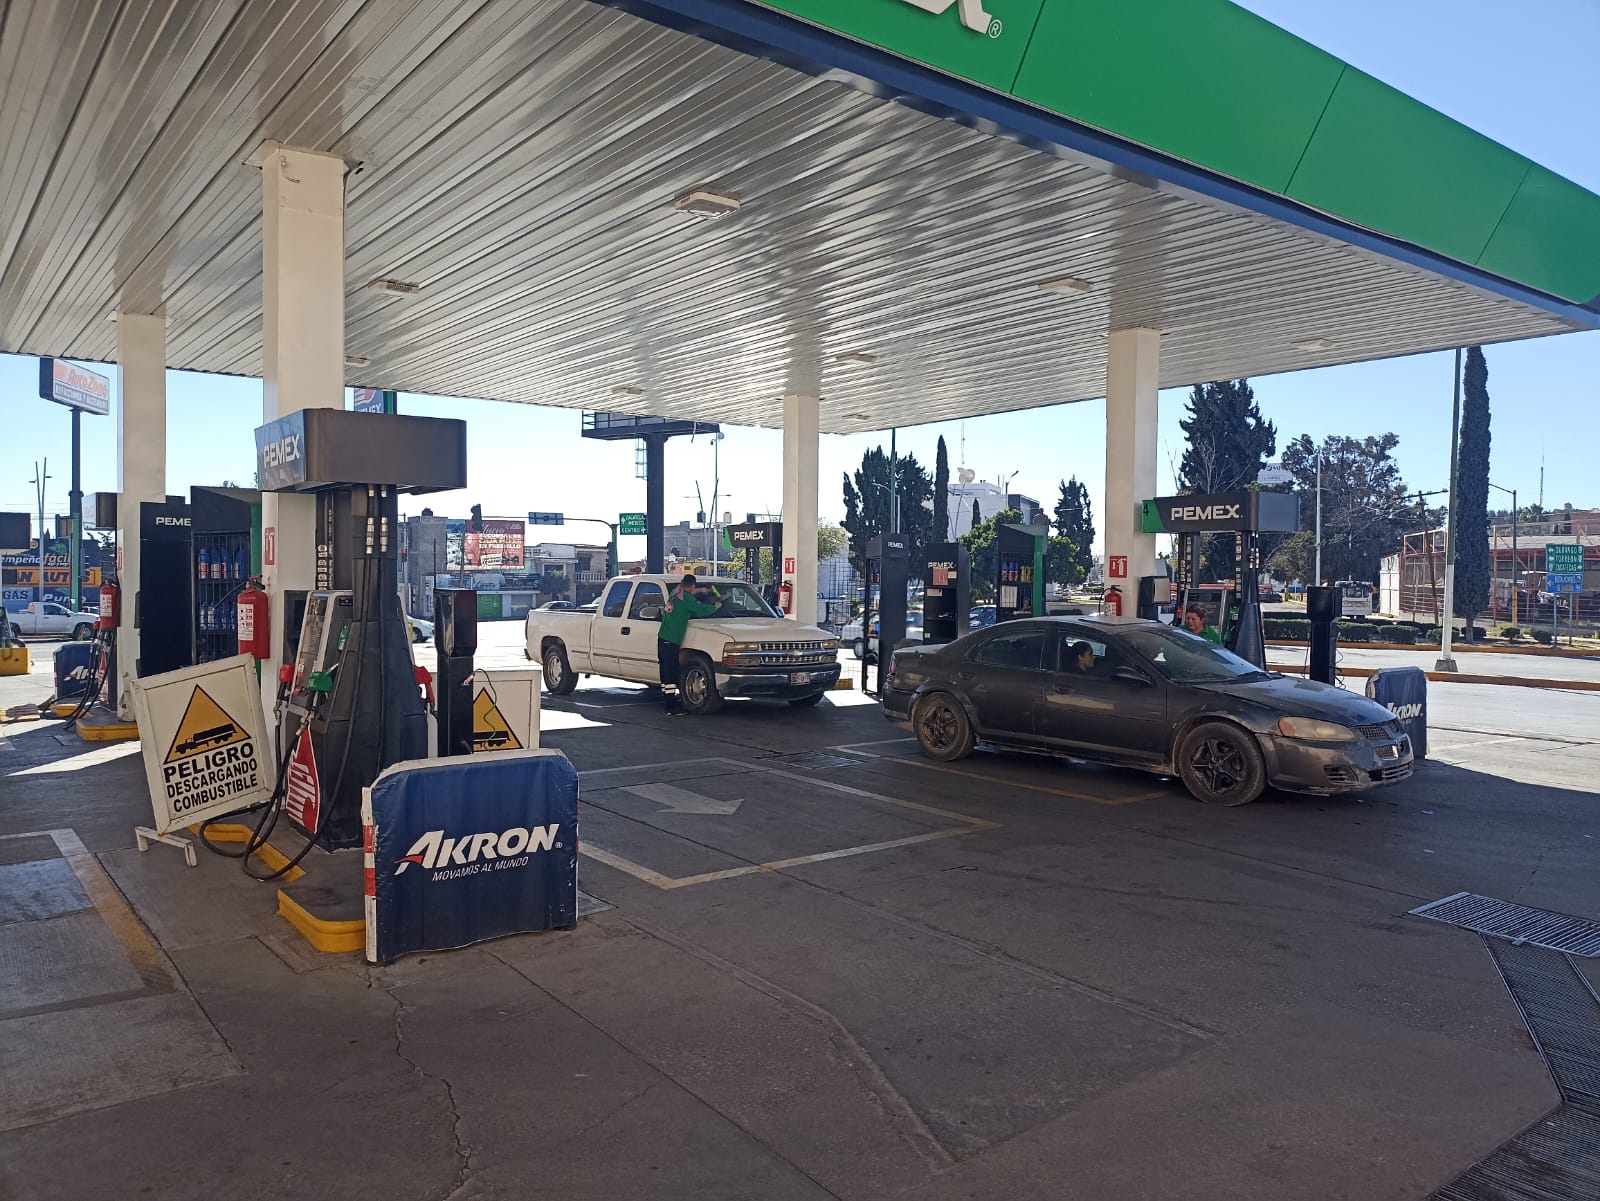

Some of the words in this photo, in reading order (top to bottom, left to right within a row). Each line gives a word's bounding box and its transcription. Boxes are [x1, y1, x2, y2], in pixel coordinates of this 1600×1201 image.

[68, 368, 108, 396] AutoZone
[263, 432, 300, 469] PEMEX
[155, 516, 191, 527] PEME
[1143, 502, 1150, 517] 4
[1171, 504, 1240, 520] PEMEX
[734, 530, 764, 541] PEMEX
[887, 541, 903, 549] PEMEX
[928, 561, 954, 569] PEMEX
[163, 742, 254, 783] PELIGRO
[166, 758, 257, 798] DESCARGANDO
[173, 774, 258, 813] COMBUSTIBLE
[394, 823, 560, 876] AKRON
[432, 863, 481, 882] MOVAMOS
[481, 863, 492, 873] AL
[494, 856, 529, 871] MUNDO
